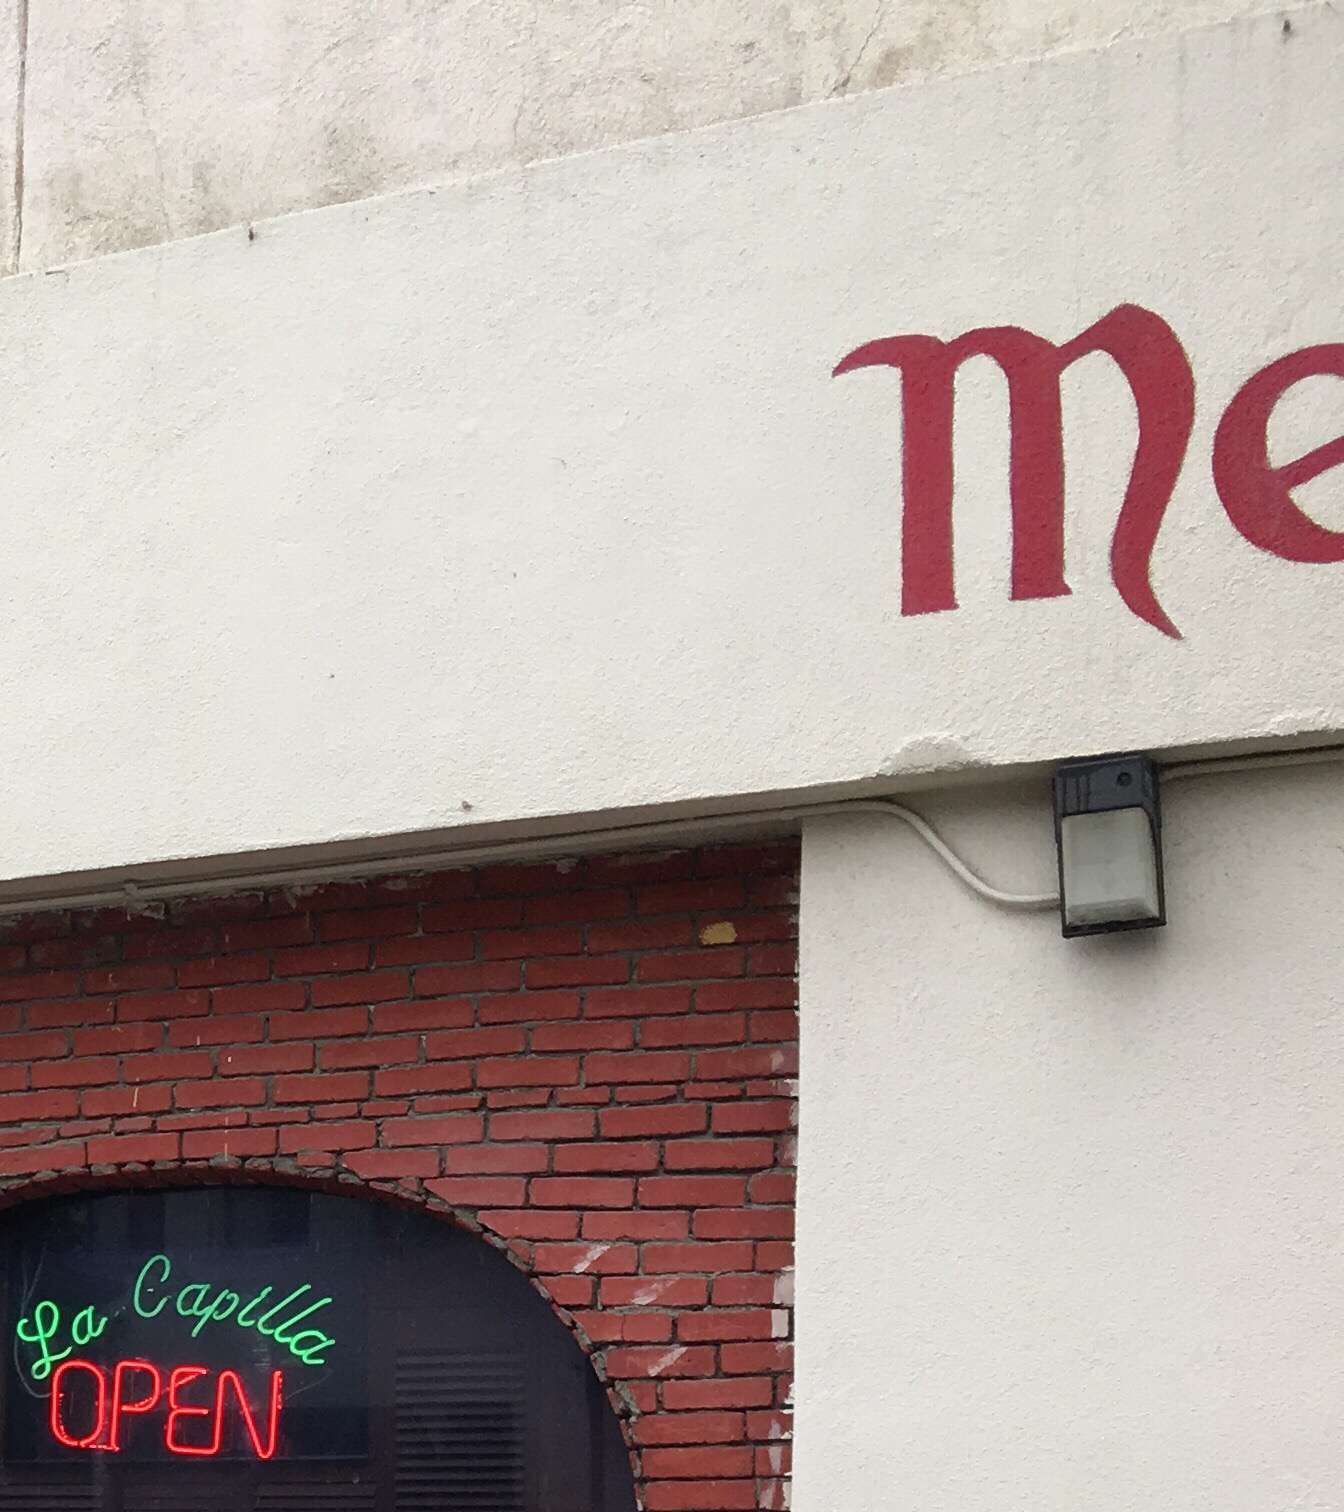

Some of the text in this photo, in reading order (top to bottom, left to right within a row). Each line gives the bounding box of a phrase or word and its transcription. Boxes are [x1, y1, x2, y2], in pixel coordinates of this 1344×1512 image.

[831, 303, 1344, 641] Me
[17, 1253, 336, 1380] La Capilla
[49, 1358, 284, 1460] OPEN
